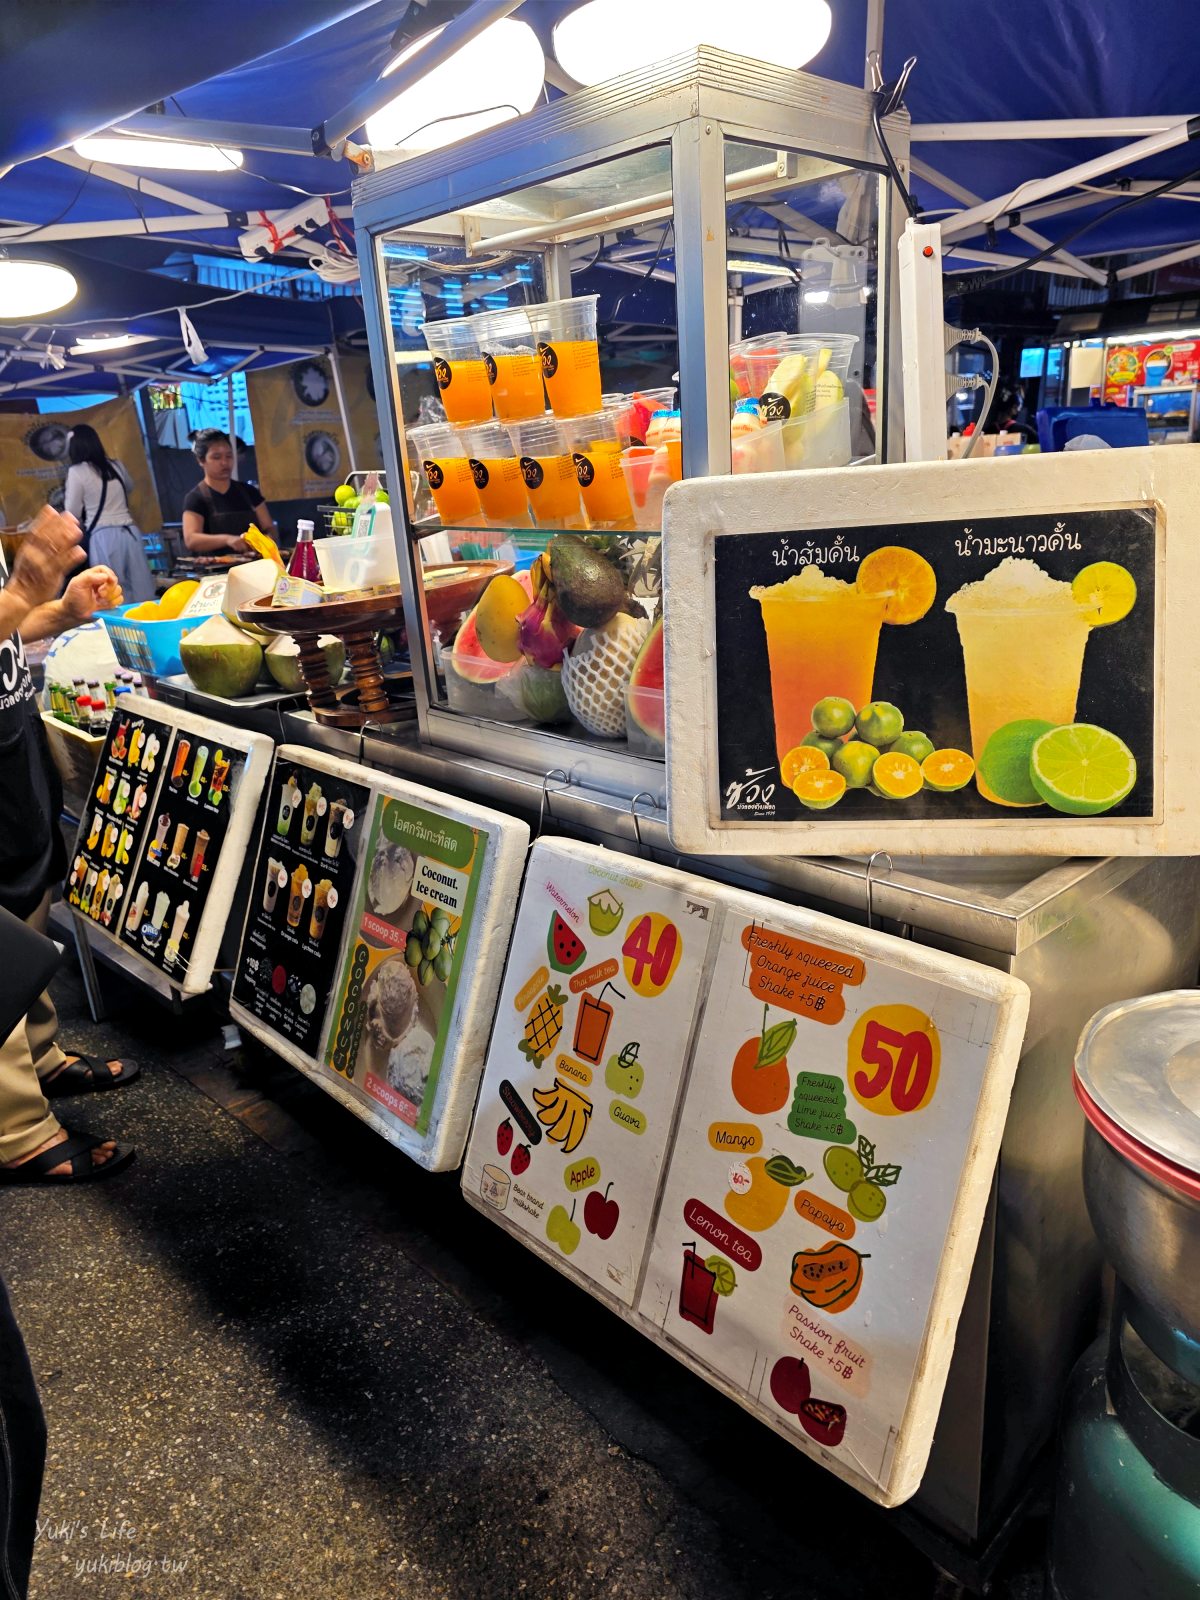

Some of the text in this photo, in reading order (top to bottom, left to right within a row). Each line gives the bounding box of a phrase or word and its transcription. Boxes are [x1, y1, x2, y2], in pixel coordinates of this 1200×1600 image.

[772, 535, 860, 566] น้ำส้มคั้น
[954, 522, 1082, 557] น้ำมะนาวคั้น
[416, 881, 458, 909] Ice cream
[545, 880, 581, 925] Watermelon
[367, 921, 390, 938] scoop
[621, 914, 678, 987] 40
[748, 931, 854, 979] Freshly squeezed
[573, 965, 616, 989] Thai milk tea
[756, 955, 836, 993] Orange juice
[758, 975, 795, 1000] Shake
[336, 950, 366, 1066] COCONUT
[558, 1059, 588, 1082] Banana
[854, 1020, 933, 1113] 50
[371, 1084, 399, 1109] scoops
[801, 1076, 837, 1093] Freshly
[798, 1091, 840, 1106] squeezed
[613, 1106, 641, 1128] Guava
[794, 1119, 822, 1132] Shake
[796, 1105, 841, 1120] Lime juice
[715, 1130, 756, 1150] Mango
[570, 1165, 596, 1187] Apple
[513, 1184, 545, 1210] Bear brand
[513, 1196, 540, 1219] milkshake
[800, 1198, 847, 1234] Papaya
[688, 1207, 752, 1263] Lemon tea
[788, 1304, 867, 1370] Passion fruit
[789, 1326, 825, 1360] Shake
